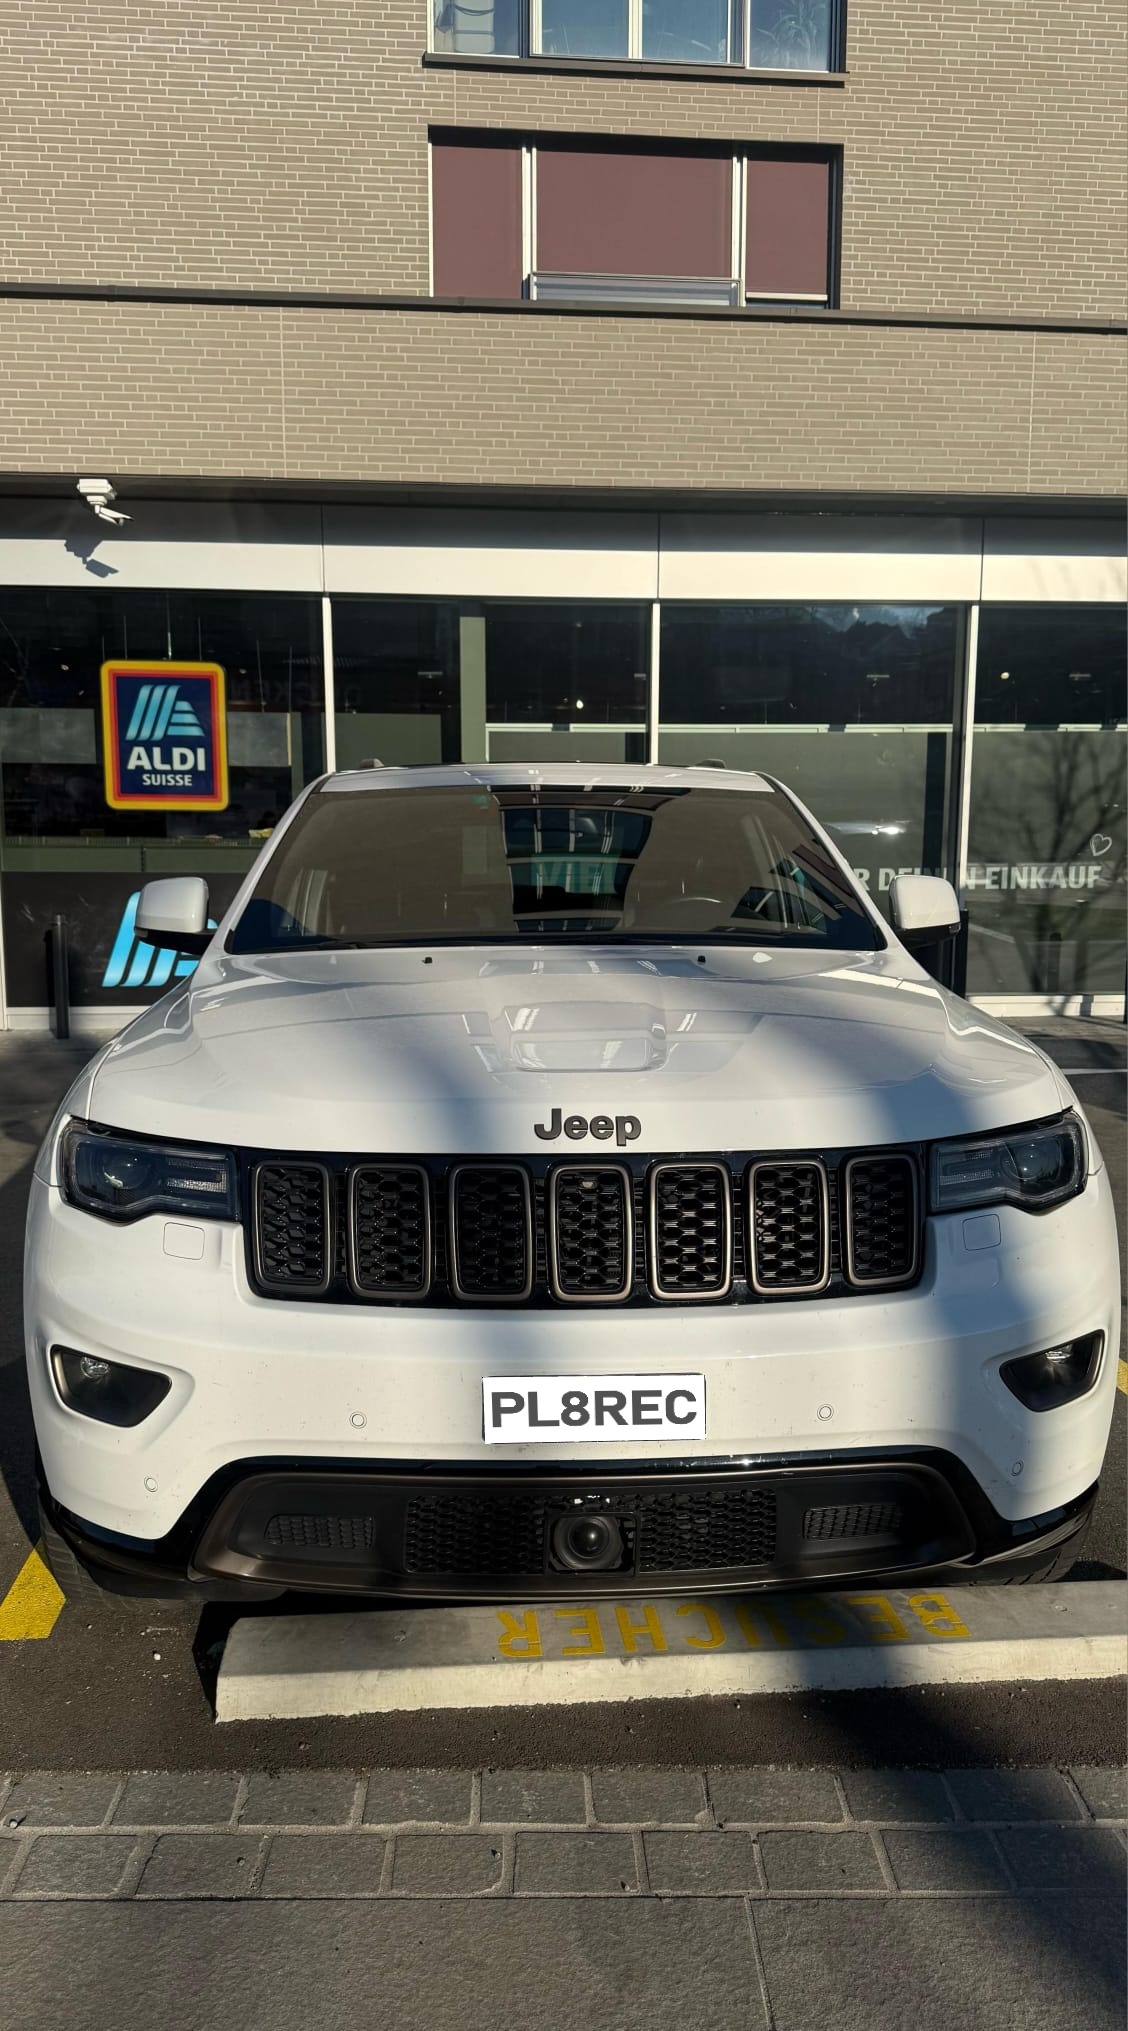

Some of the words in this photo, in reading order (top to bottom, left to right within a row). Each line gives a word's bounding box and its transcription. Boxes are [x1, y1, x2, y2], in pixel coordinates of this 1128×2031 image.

[127, 746, 206, 771] ALDI
[142, 774, 193, 787] SUISSE
[985, 865, 1103, 890] EINKAUF
[534, 1108, 642, 1147] Jeep
[491, 1389, 697, 1428] PL8REC
[498, 1593, 972, 1658] BESUCHER
